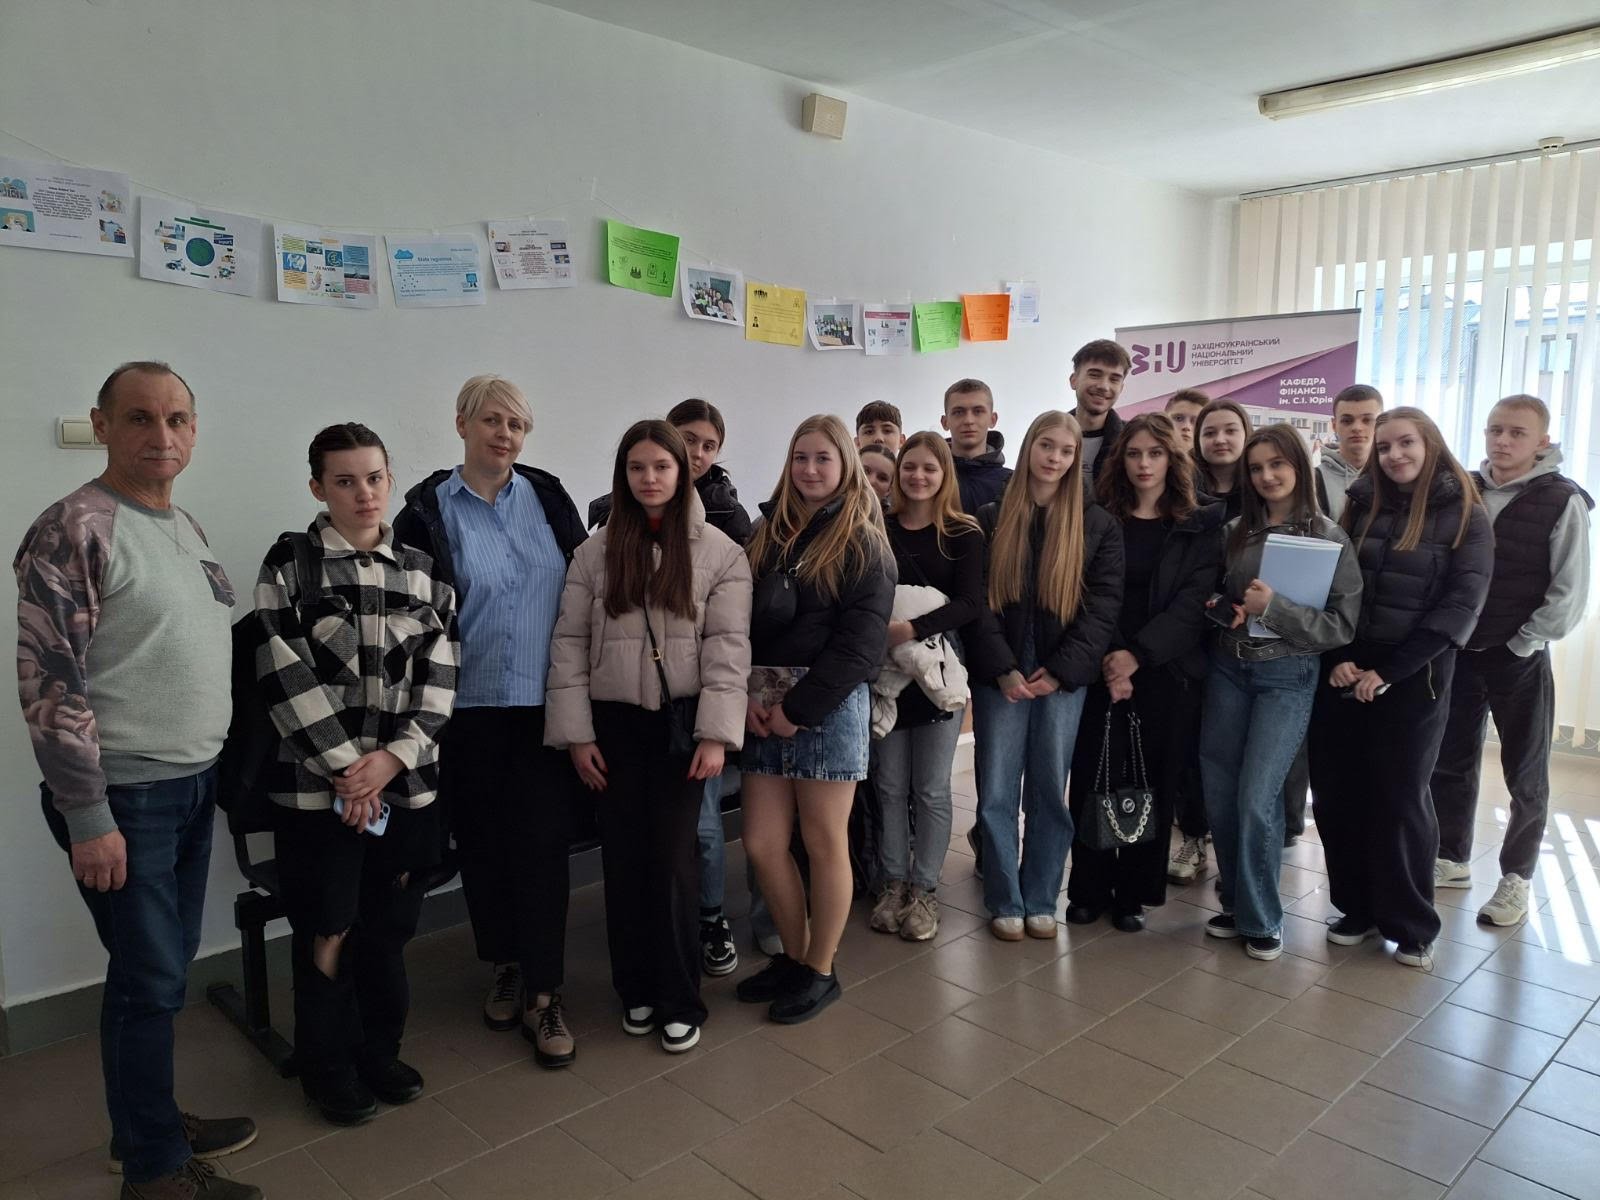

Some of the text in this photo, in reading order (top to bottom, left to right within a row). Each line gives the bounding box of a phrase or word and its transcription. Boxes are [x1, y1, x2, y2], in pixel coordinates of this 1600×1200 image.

[1191, 338, 1280, 351] ЗАХІДНОУКРАЇНСЬКИЙ
[1191, 349, 1254, 359] НАЦІОНАЛЬНИЙ
[1191, 357, 1244, 367] УНІВЕРСИТЕТ
[1279, 377, 1327, 387] КАФЕДРА
[1279, 387, 1326, 395] ФІНАНСІВ
[1309, 396, 1333, 405] Юрія
